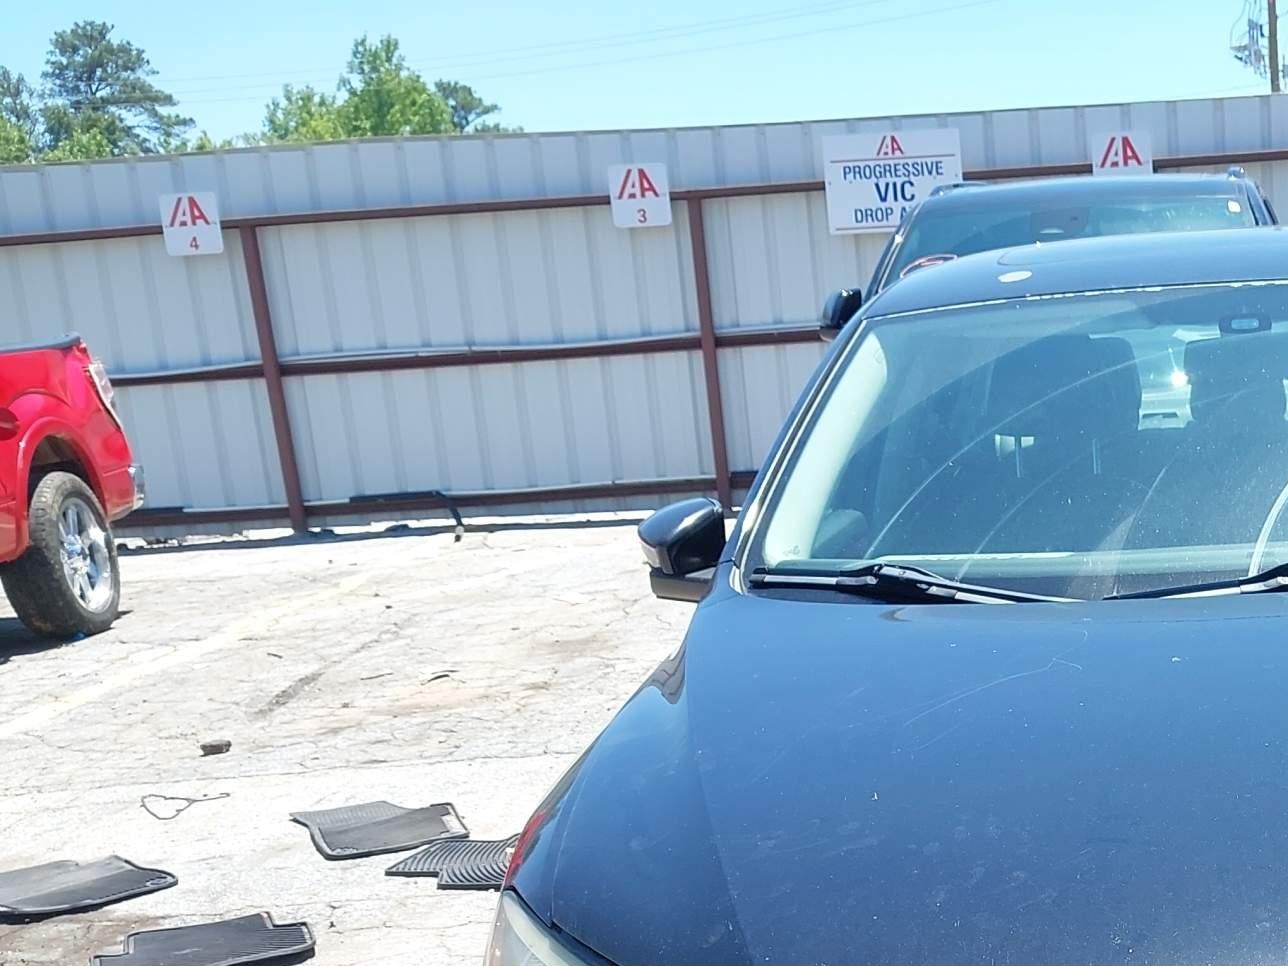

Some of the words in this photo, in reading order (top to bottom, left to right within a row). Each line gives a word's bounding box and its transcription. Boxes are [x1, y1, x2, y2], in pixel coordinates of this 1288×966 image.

[842, 161, 943, 181] PROGRESSIVE
[874, 180, 915, 203] VIC
[637, 208, 647, 223] 3
[854, 206, 894, 223] DROP
[190, 236, 199, 250] 4
